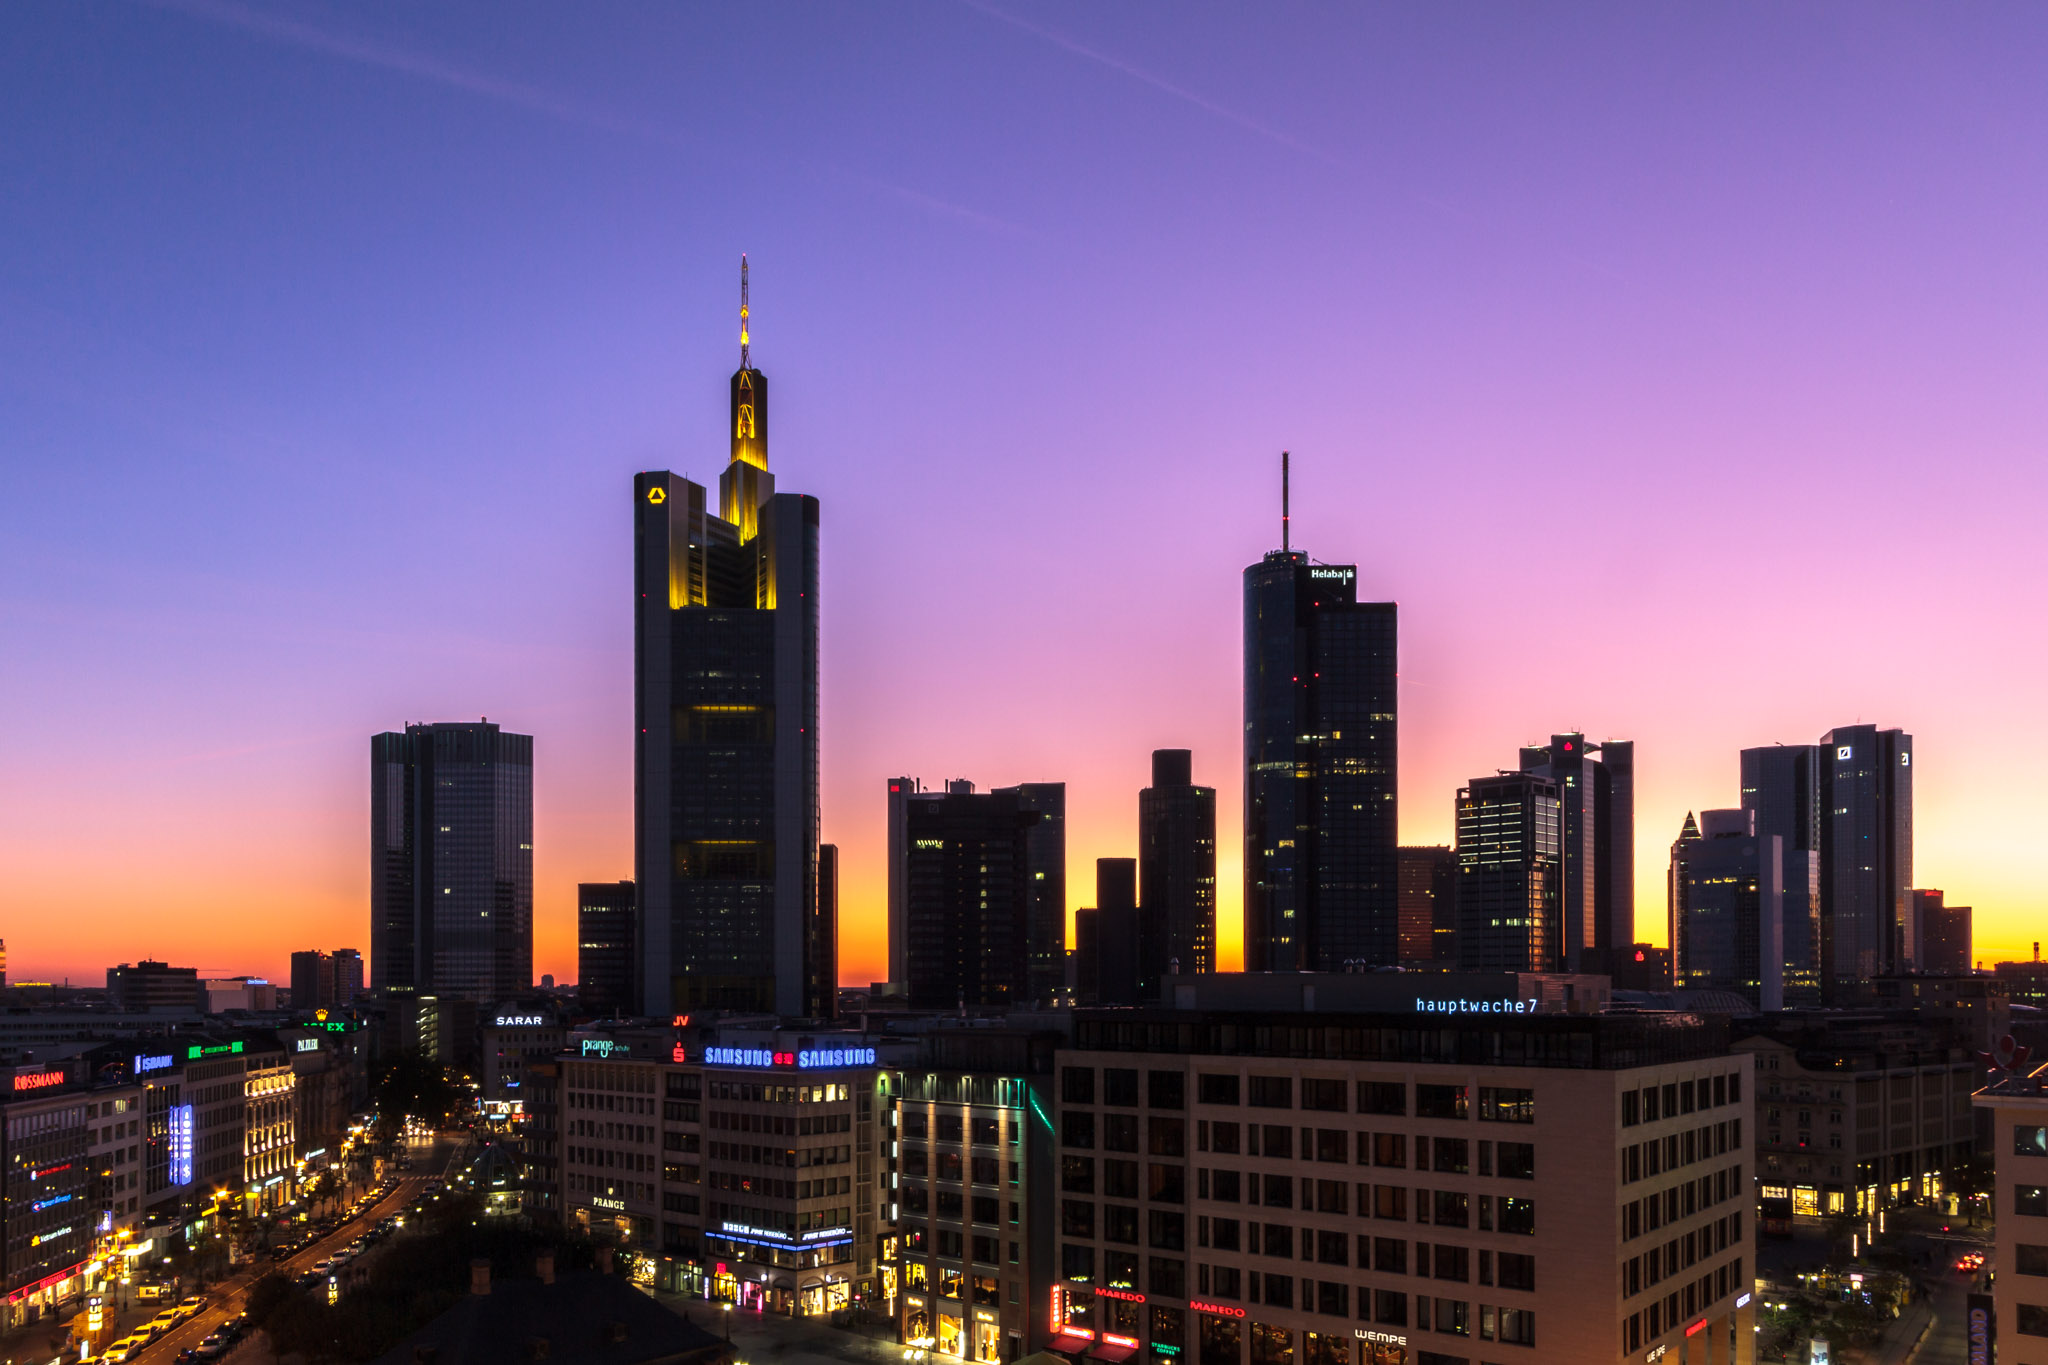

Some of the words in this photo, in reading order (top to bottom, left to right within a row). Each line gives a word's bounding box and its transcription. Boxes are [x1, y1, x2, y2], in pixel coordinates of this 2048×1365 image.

[1311, 569, 1343, 579] Helaba
[496, 1016, 543, 1026] SARAR
[672, 1015, 689, 1027] JV
[582, 1039, 614, 1058] prange
[705, 1046, 773, 1067] SAMSUNG
[798, 1048, 876, 1068] SAMSUNG
[14, 1071, 65, 1091] ROSSMANN
[593, 1196, 625, 1211] PRANGE
[1095, 1287, 1146, 1304] MAREDO
[1190, 1300, 1247, 1318] MAREDO
[1354, 1328, 1408, 1346] WEMPE
